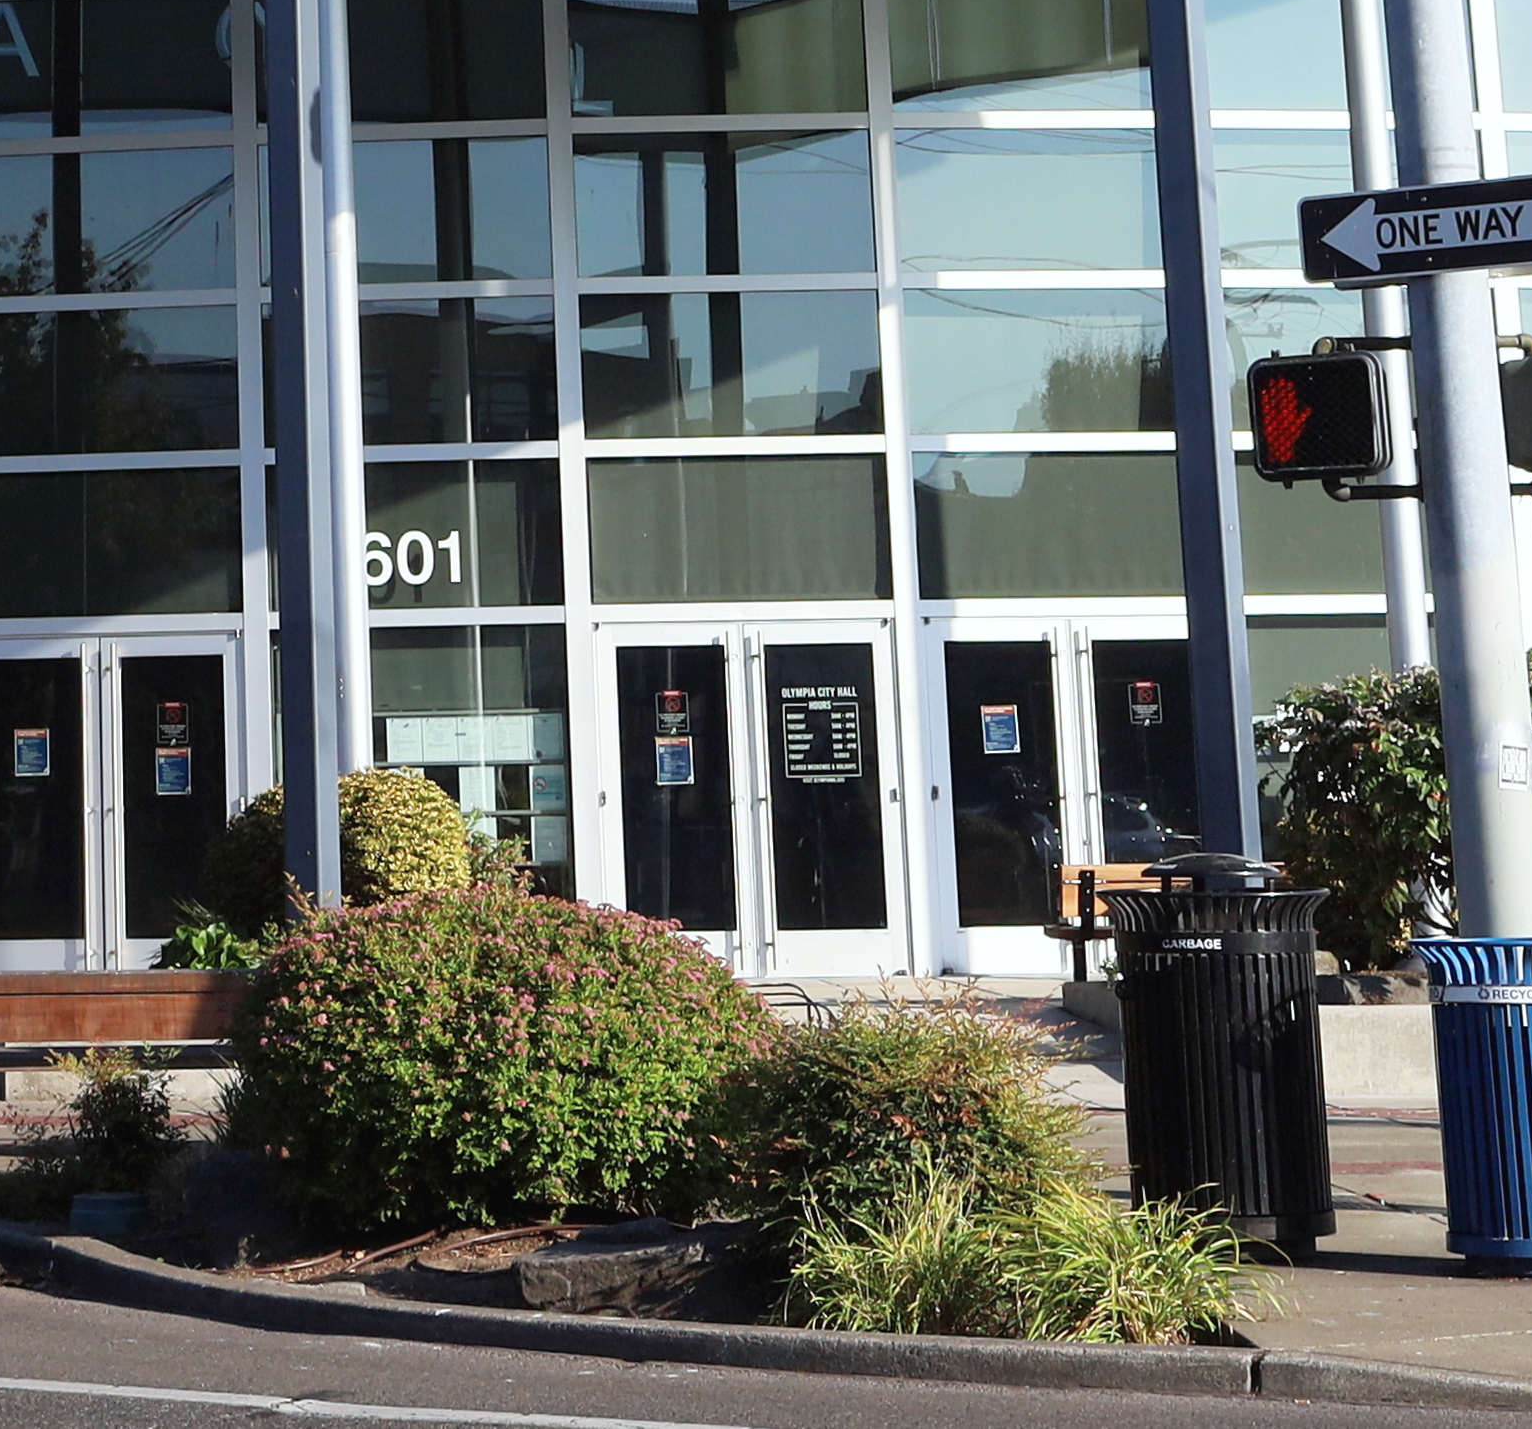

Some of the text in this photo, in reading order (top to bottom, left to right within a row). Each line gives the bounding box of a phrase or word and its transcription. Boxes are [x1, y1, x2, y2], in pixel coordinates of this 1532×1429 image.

[1376, 204, 1525, 250] ONE WAY
[364, 530, 462, 586] 601
[781, 686, 858, 698] OLYMPIA CITY HALL
[808, 700, 832, 710] HOURS
[1162, 938, 1223, 950] GARBAGE
